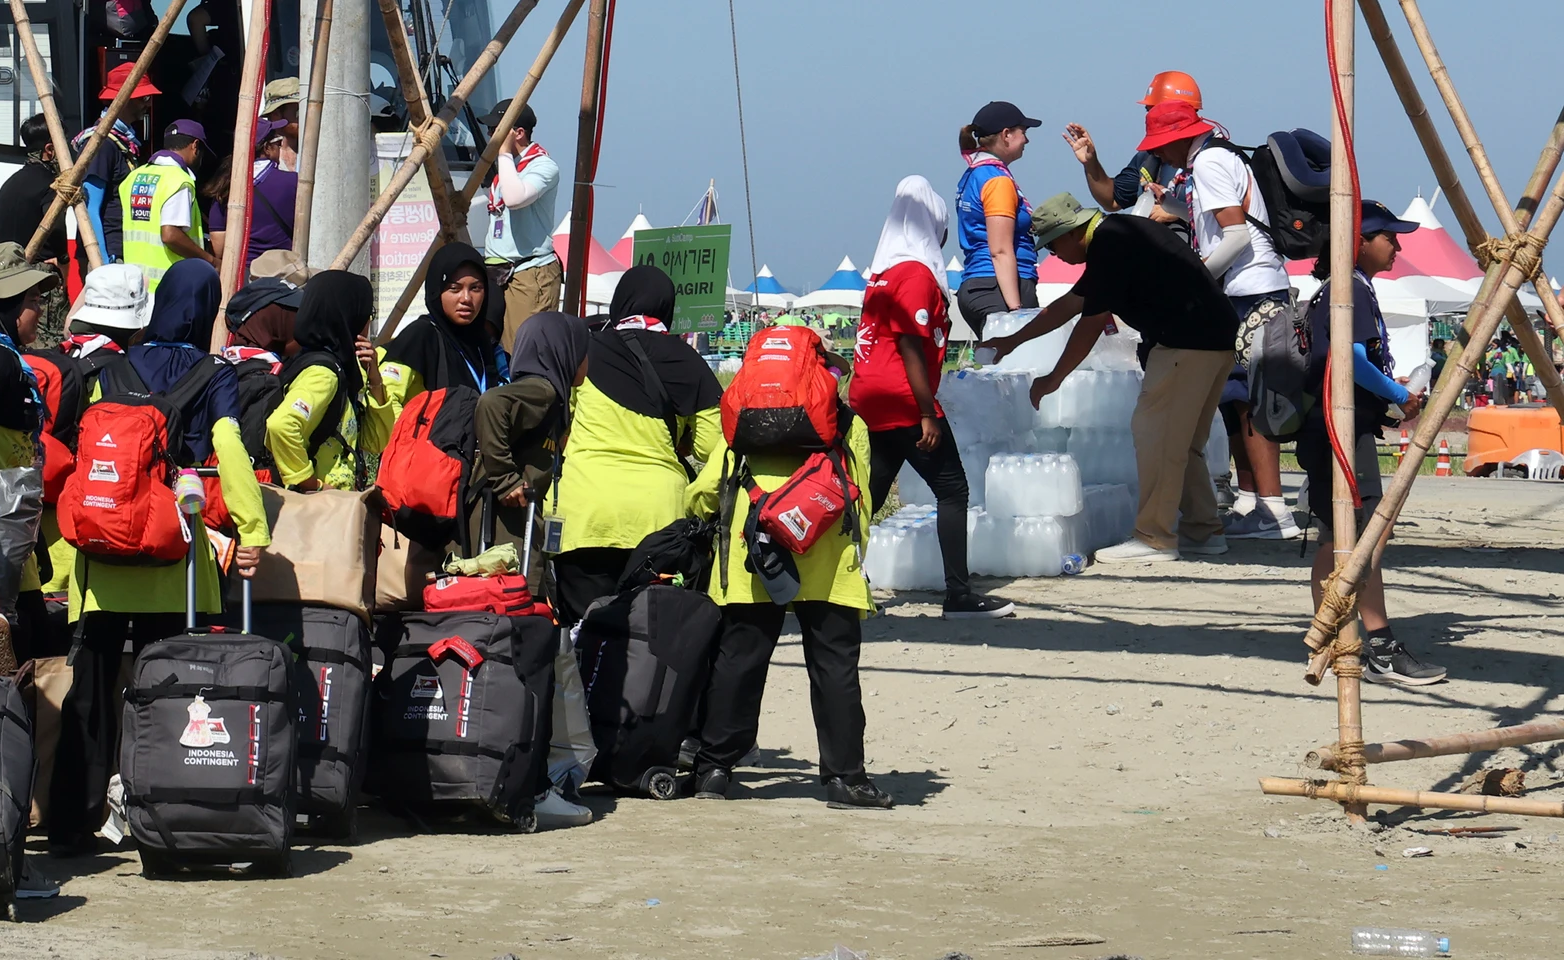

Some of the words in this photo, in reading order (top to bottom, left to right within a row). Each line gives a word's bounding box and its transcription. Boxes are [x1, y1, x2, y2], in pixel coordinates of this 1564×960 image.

[135, 175, 160, 184] SAFE
[662, 248, 716, 276] 아사기리
[675, 282, 714, 296] AGIRI
[316, 666, 333, 741] EIGER
[407, 705, 445, 713] INDONESIA
[403, 712, 449, 721] CONTINGENT
[188, 749, 235, 759] INDONESIA
[183, 757, 239, 767] CONTINGENT
